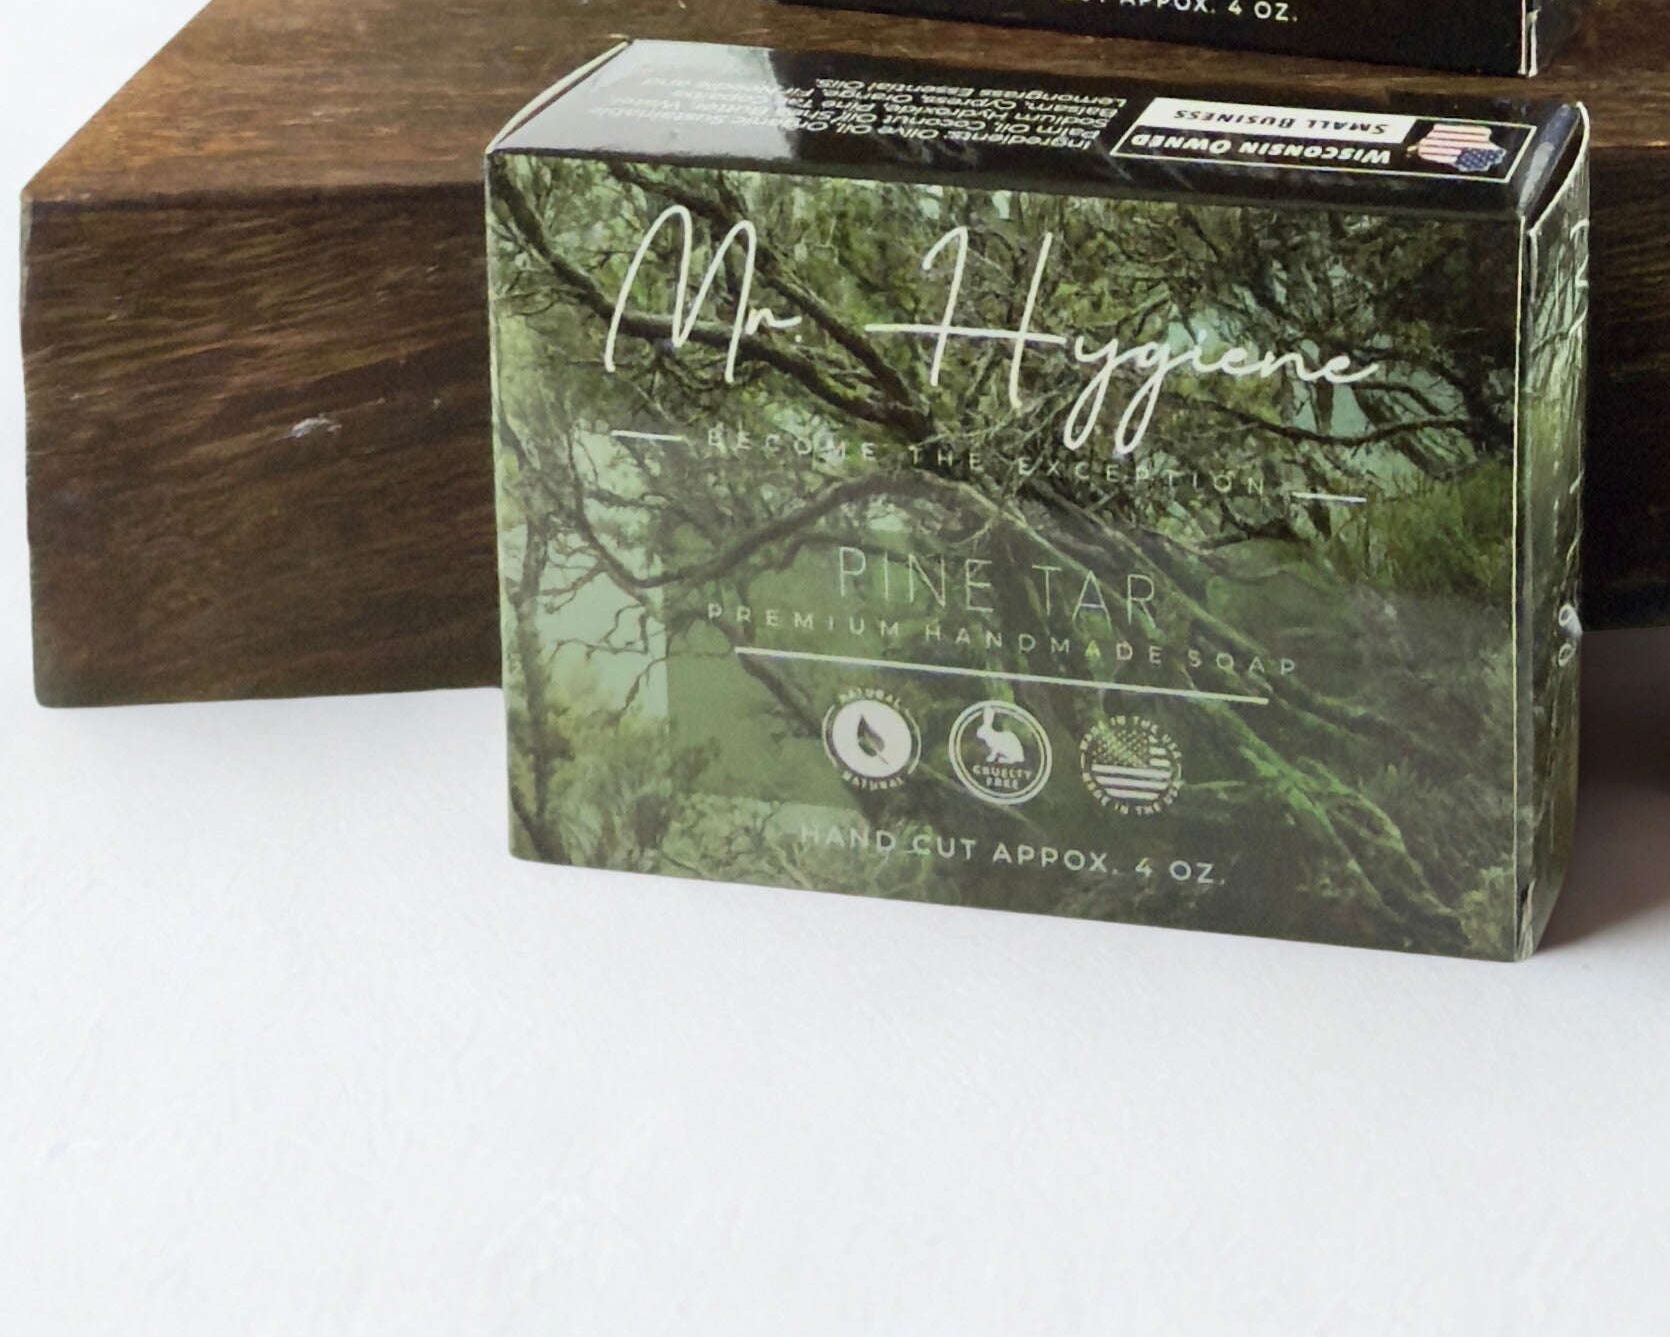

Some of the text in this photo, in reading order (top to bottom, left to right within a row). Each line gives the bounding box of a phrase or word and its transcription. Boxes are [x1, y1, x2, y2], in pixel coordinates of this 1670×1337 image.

[1229, 0, 1242, 15] 4
[1255, 1, 1298, 22] OZ.
[867, 82, 975, 98] Essential
[979, 89, 1128, 108] Lemongrass
[1025, 101, 1119, 118] Balsam,
[883, 115, 986, 131] Coconut
[1013, 113, 1111, 128] Sodium
[1174, 110, 1389, 135] SMALL BUSINESS
[878, 126, 940, 140] Olive
[944, 130, 1092, 150] Ingredients:
[1036, 124, 1100, 140] Palm
[1131, 134, 1391, 164] WISCONSIN OWNED
[604, 205, 802, 383] Mr.
[865, 225, 1380, 455] Hygiene
[707, 421, 1266, 495] BECOME THE EXCEPTION
[839, 546, 1158, 629] PINE TAR
[707, 603, 1297, 676] PREMIUM HANDMADE SOAP
[800, 824, 1226, 886] HAND CUT APPOX. 4 OZ.
